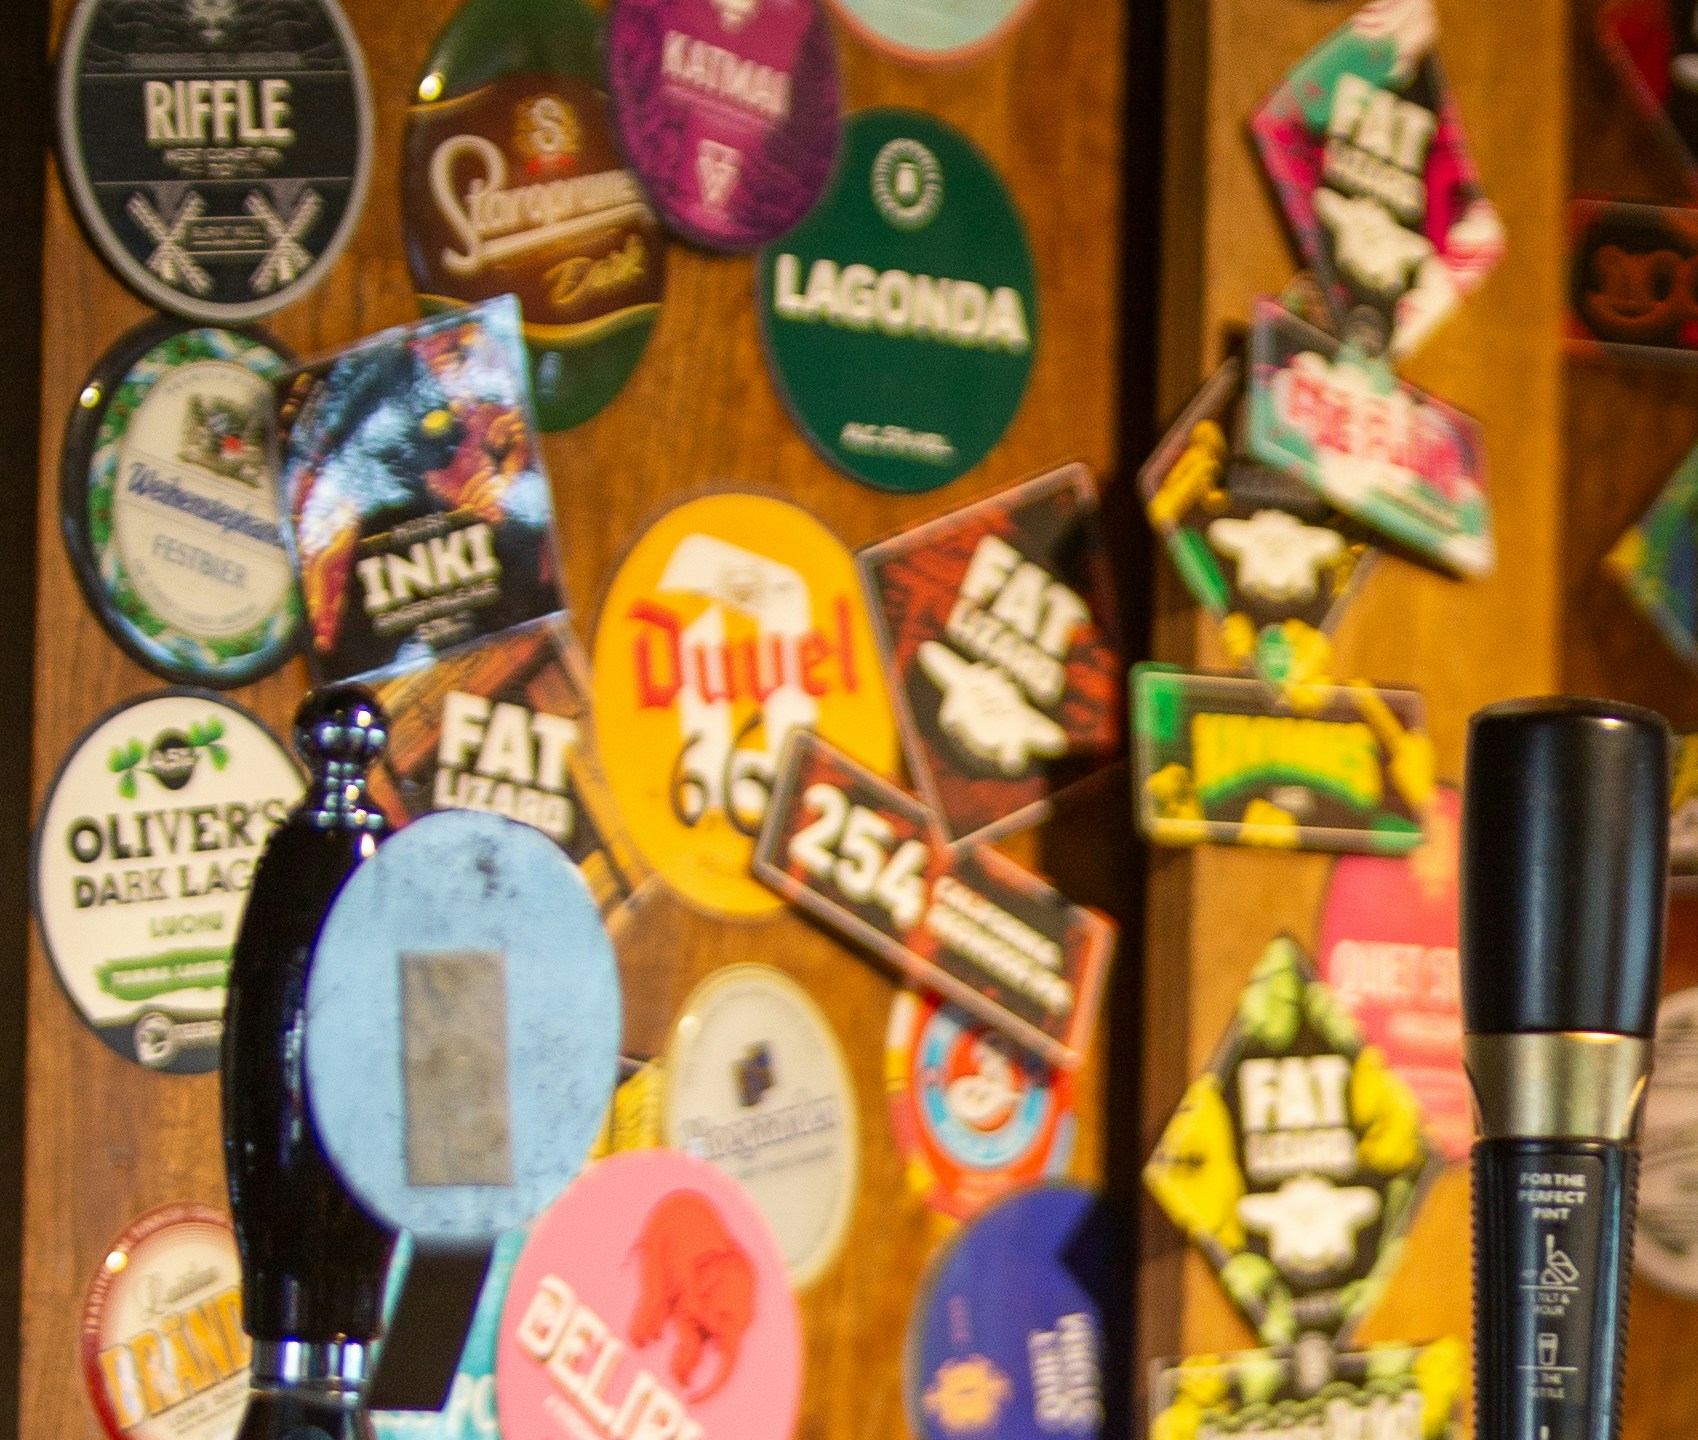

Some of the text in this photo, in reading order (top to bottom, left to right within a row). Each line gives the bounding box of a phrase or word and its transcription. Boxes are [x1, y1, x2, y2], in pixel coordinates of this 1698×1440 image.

[143, 77, 297, 149] RIFFLE
[774, 253, 1032, 356] LAGONDA
[151, 533, 249, 589] FESTBIER
[355, 521, 502, 614] INKI
[956, 534, 1094, 660] FAT
[626, 593, 859, 710] Duvel
[436, 689, 581, 797] FAT
[67, 798, 289, 865] OLIVER'S
[431, 766, 576, 844] LIZARD
[74, 856, 256, 912] DARK LAG
[788, 781, 932, 930] 254
[1236, 1052, 1353, 1133] FAT
[1517, 1189, 1588, 1207] PERFECT
[1519, 1172, 1587, 1190] FOR THE
[1530, 1206, 1572, 1222] PINT
